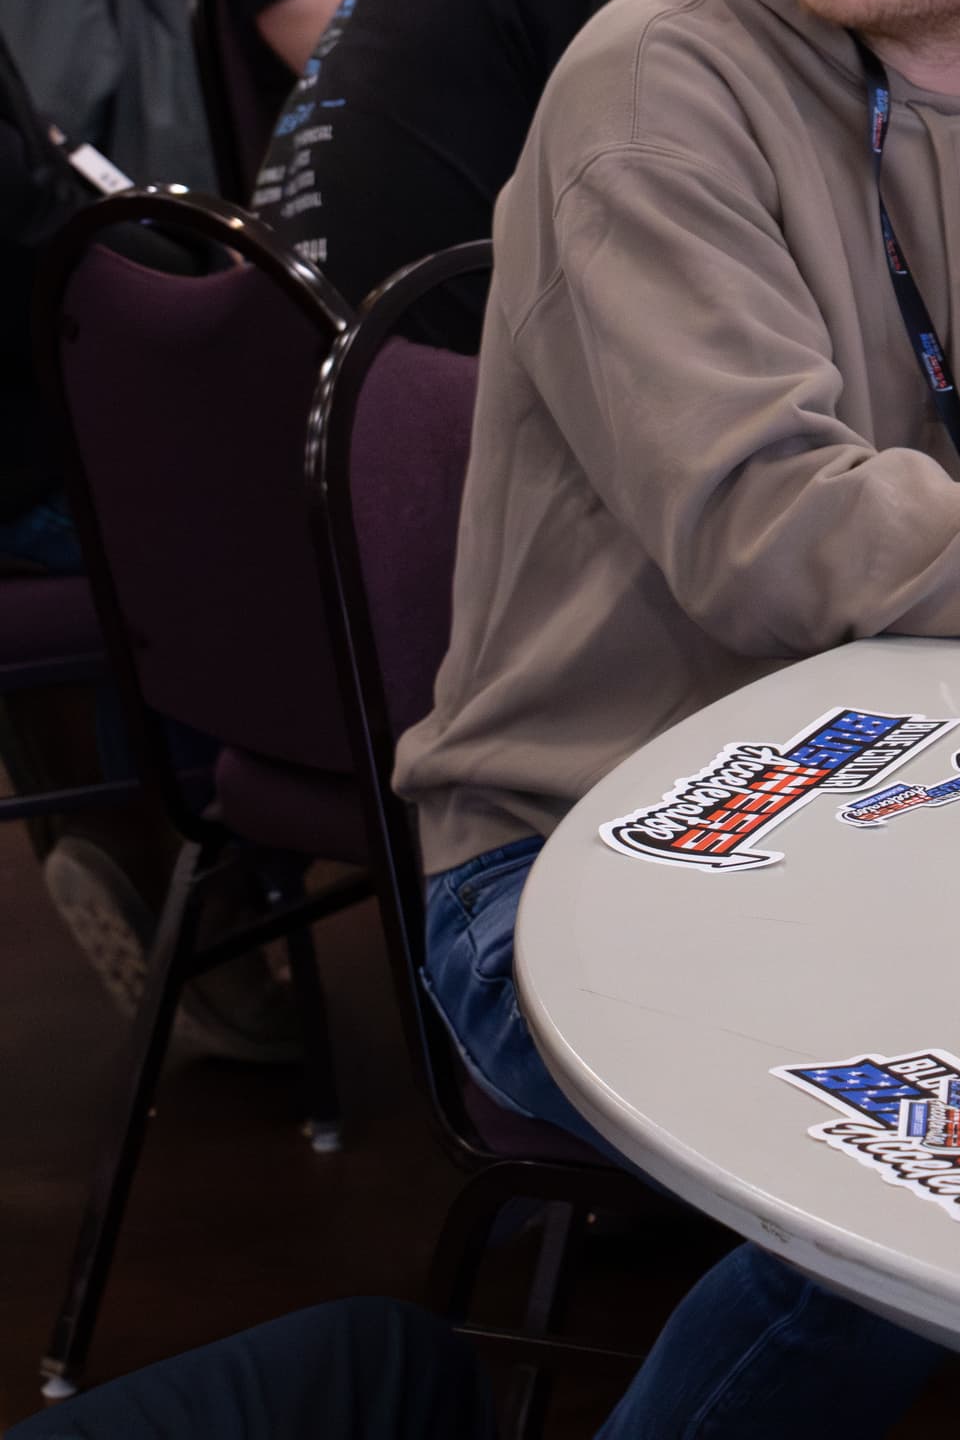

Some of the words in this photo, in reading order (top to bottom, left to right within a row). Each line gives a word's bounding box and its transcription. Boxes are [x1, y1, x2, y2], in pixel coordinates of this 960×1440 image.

[874, 721, 940, 749] BLUE
[671, 711, 903, 854] BUSINESS
[821, 748, 903, 789] COLLAR
[888, 1057, 958, 1093] BLU
